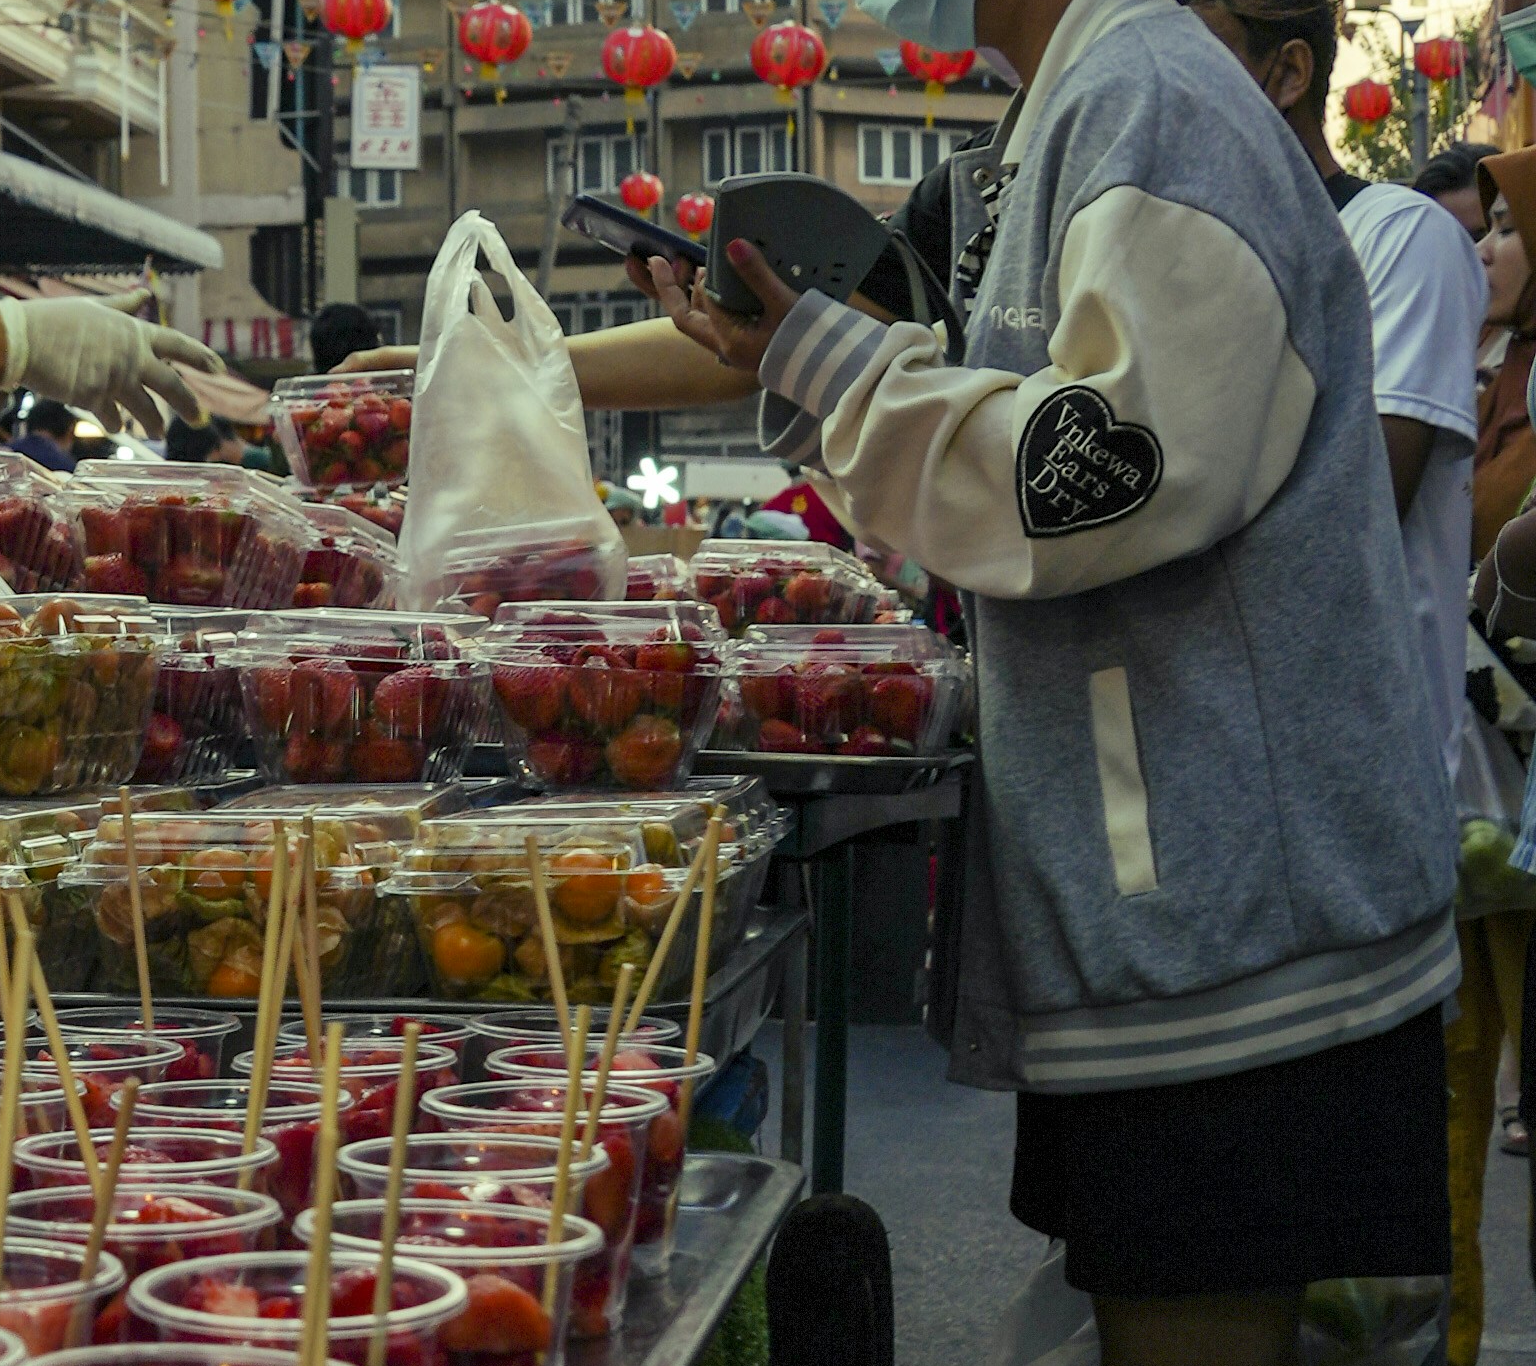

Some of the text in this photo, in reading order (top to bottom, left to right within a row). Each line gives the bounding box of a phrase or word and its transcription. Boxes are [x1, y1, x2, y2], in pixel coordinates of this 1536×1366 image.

[1045, 436, 1111, 499] Ears
[1052, 400, 1143, 490] Vnkewa
[1027, 463, 1091, 522] Dry
